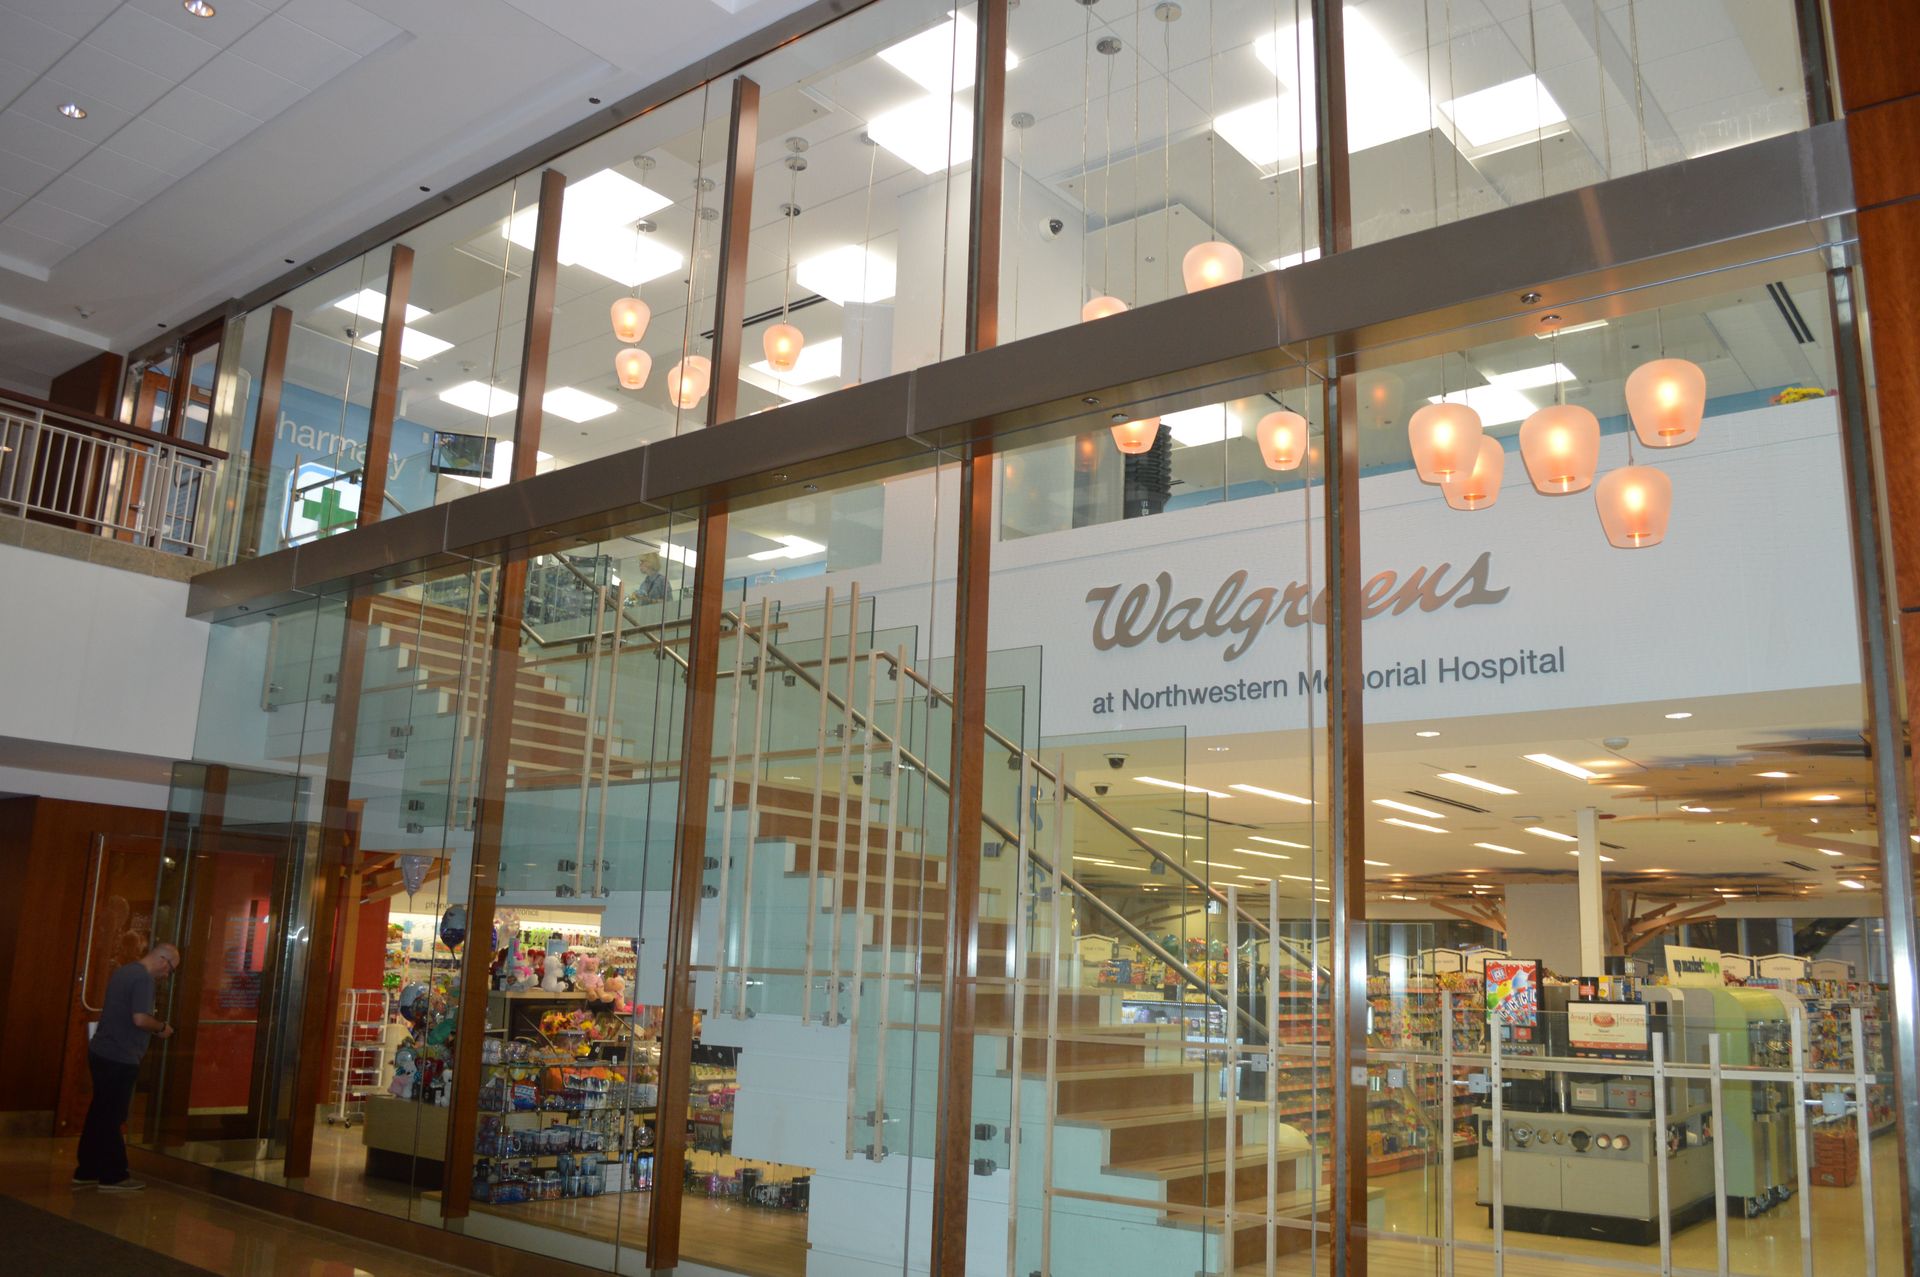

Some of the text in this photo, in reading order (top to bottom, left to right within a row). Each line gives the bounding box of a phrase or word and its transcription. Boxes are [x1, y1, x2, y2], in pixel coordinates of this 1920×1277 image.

[1086, 551, 1511, 662] Walgrens
[1092, 646, 1565, 714] at Northwestern Morial Hospital
